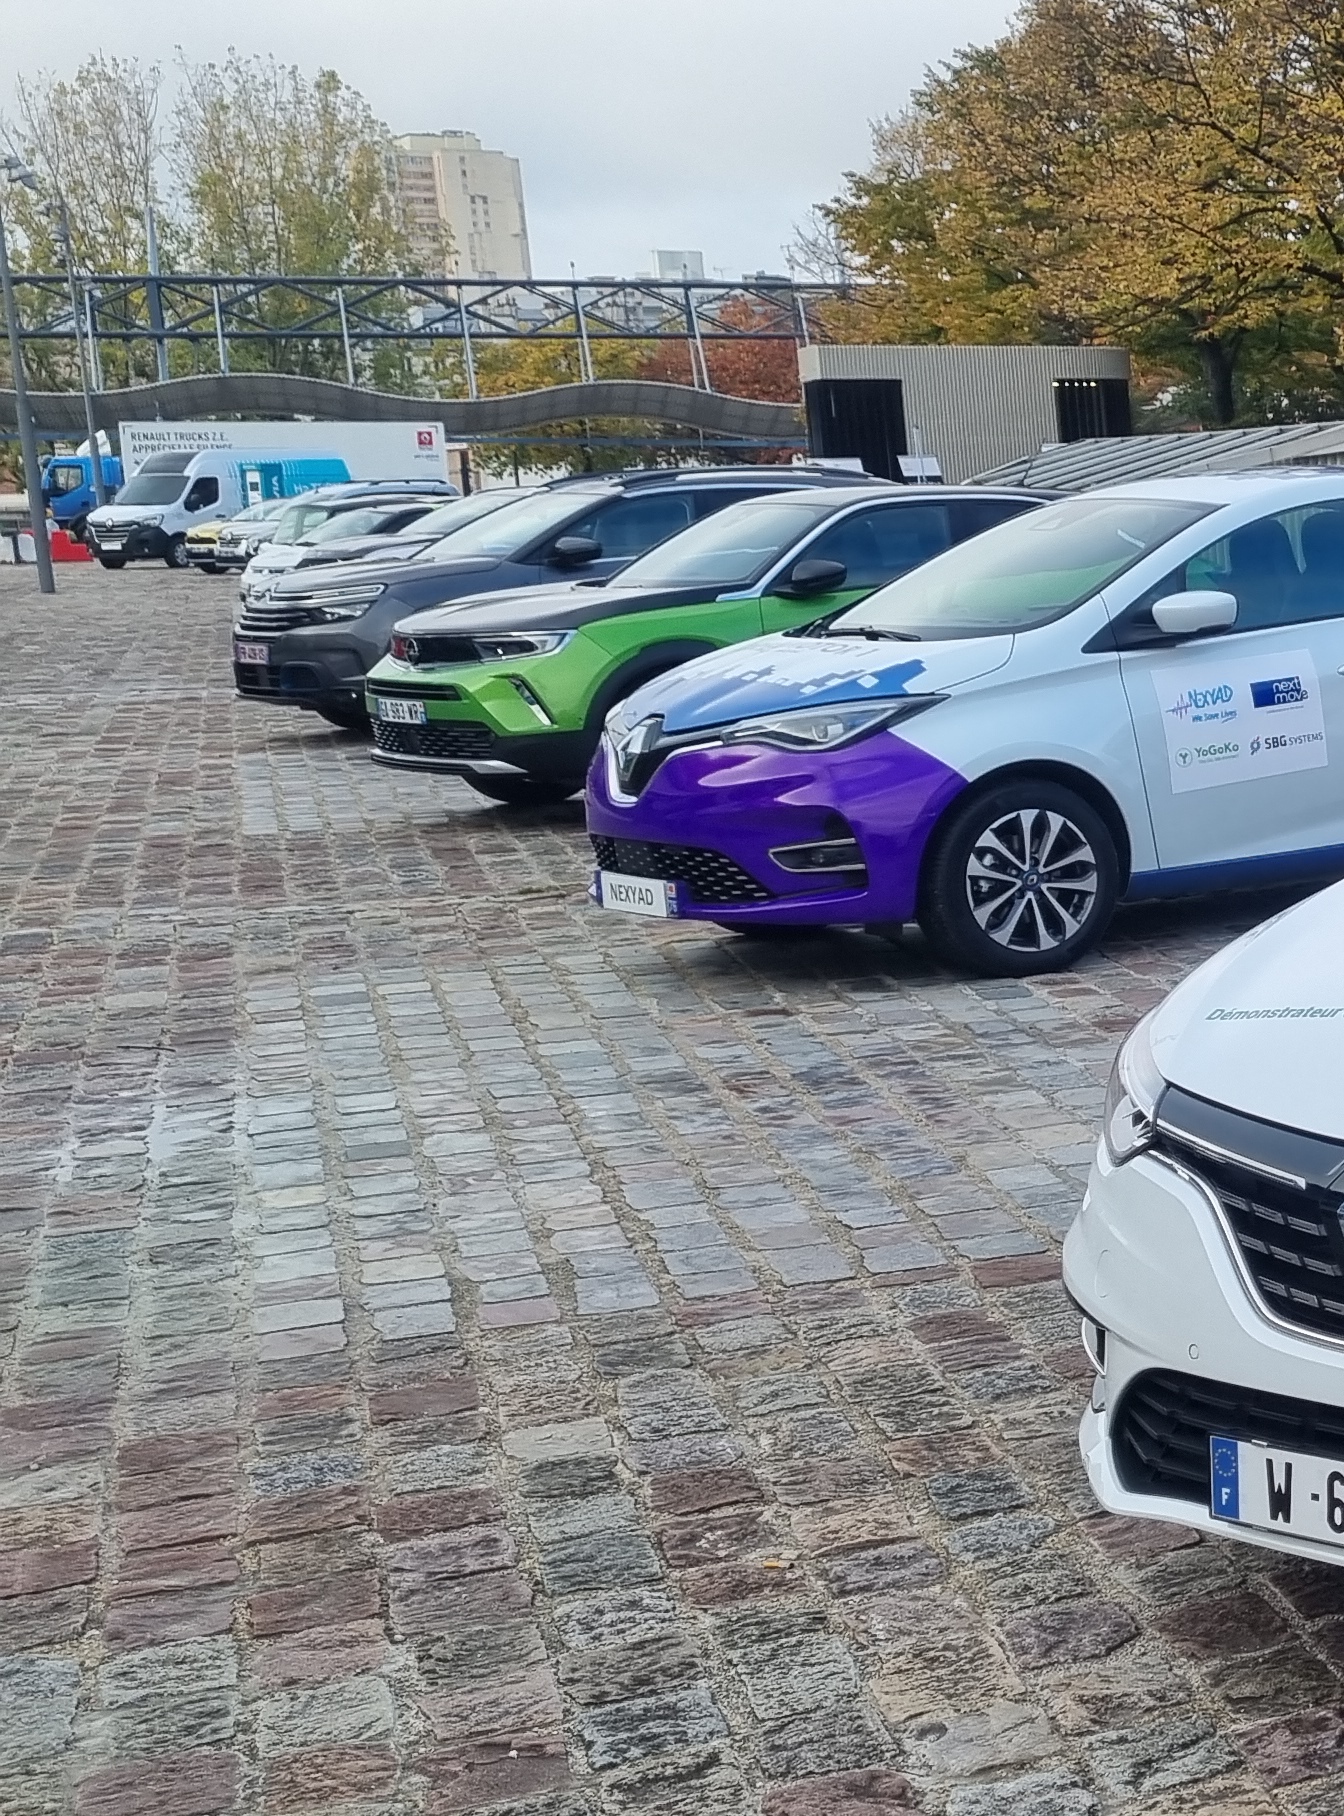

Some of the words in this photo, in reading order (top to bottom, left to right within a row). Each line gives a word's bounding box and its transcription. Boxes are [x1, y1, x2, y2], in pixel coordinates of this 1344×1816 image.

[131, 431, 171, 442] RENAULT
[173, 431, 210, 442] TRUCKS
[1272, 677, 1301, 693] next
[1274, 688, 1309, 704] move
[1264, 734, 1287, 750] SBG
[1288, 731, 1324, 746] SYSTEMS
[1194, 741, 1240, 758] YoGoKo
[609, 882, 654, 906] NEXYAD
[1205, 1006, 1344, 1022] Démonstrateur
[1220, 1487, 1231, 1506] F
